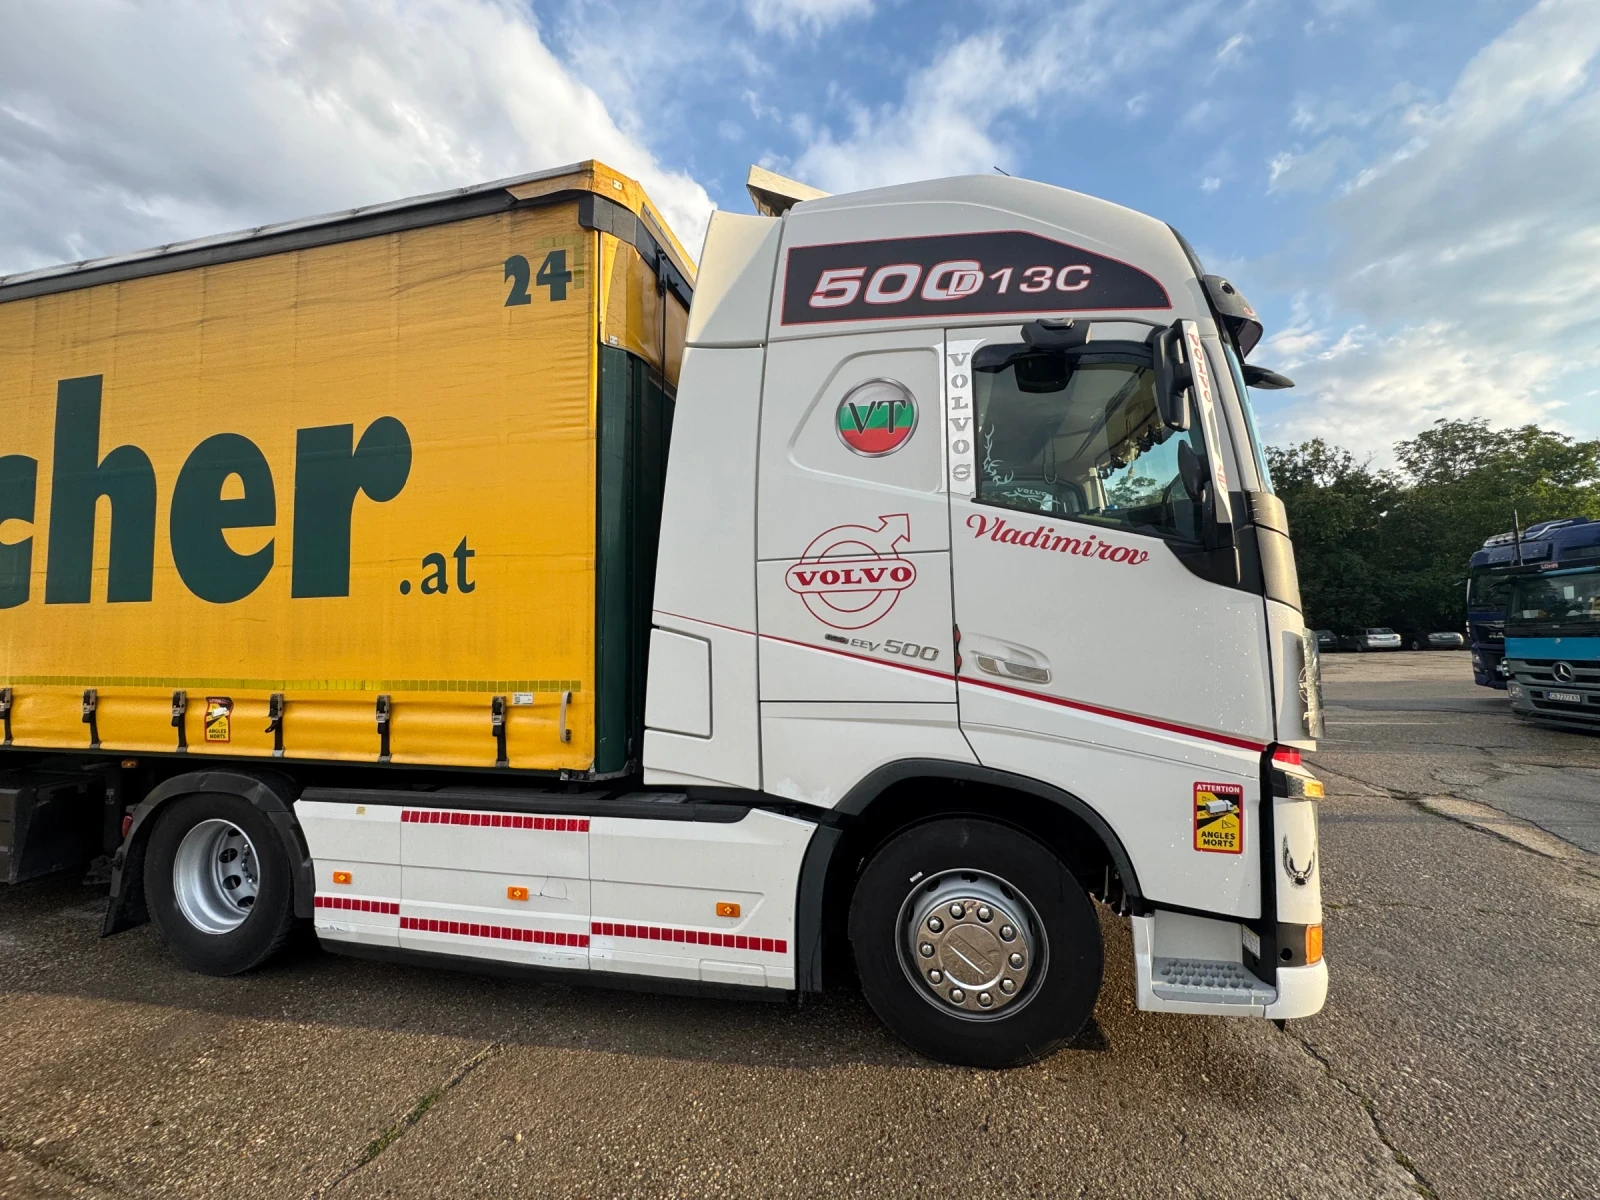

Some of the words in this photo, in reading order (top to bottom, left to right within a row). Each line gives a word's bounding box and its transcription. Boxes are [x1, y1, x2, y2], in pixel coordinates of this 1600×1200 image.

[504, 249, 573, 307] 24
[808, 260, 982, 308] 500
[948, 352, 971, 454] VOLVO
[848, 400, 906, 435] VT
[1016, 487, 1048, 496] VOLVO
[966, 513, 1150, 566] Vladimirov
[792, 566, 912, 587] VOLVO
[850, 638, 881, 652] EEV
[883, 639, 940, 662] 500
[1197, 784, 1240, 793] ATTENTION
[1201, 831, 1236, 840] ANGLES
[1203, 839, 1234, 848] MORTS
